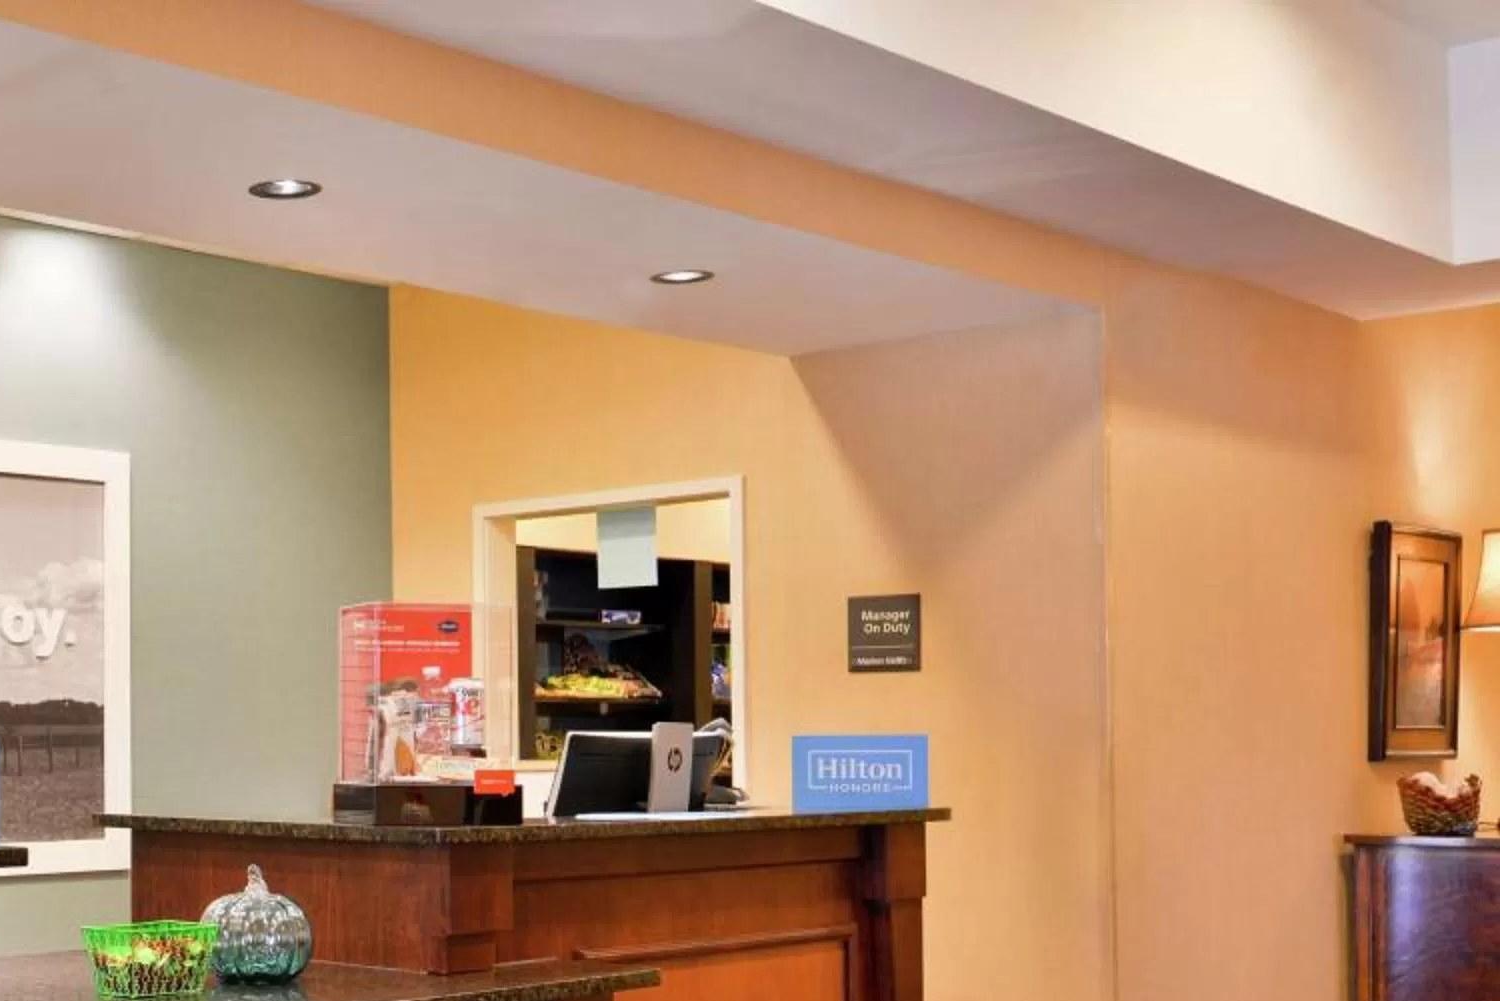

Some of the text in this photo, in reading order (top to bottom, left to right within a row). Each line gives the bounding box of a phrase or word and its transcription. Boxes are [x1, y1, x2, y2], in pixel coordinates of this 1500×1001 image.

[864, 623, 911, 635] On Duty
[817, 757, 902, 780] Hilton
